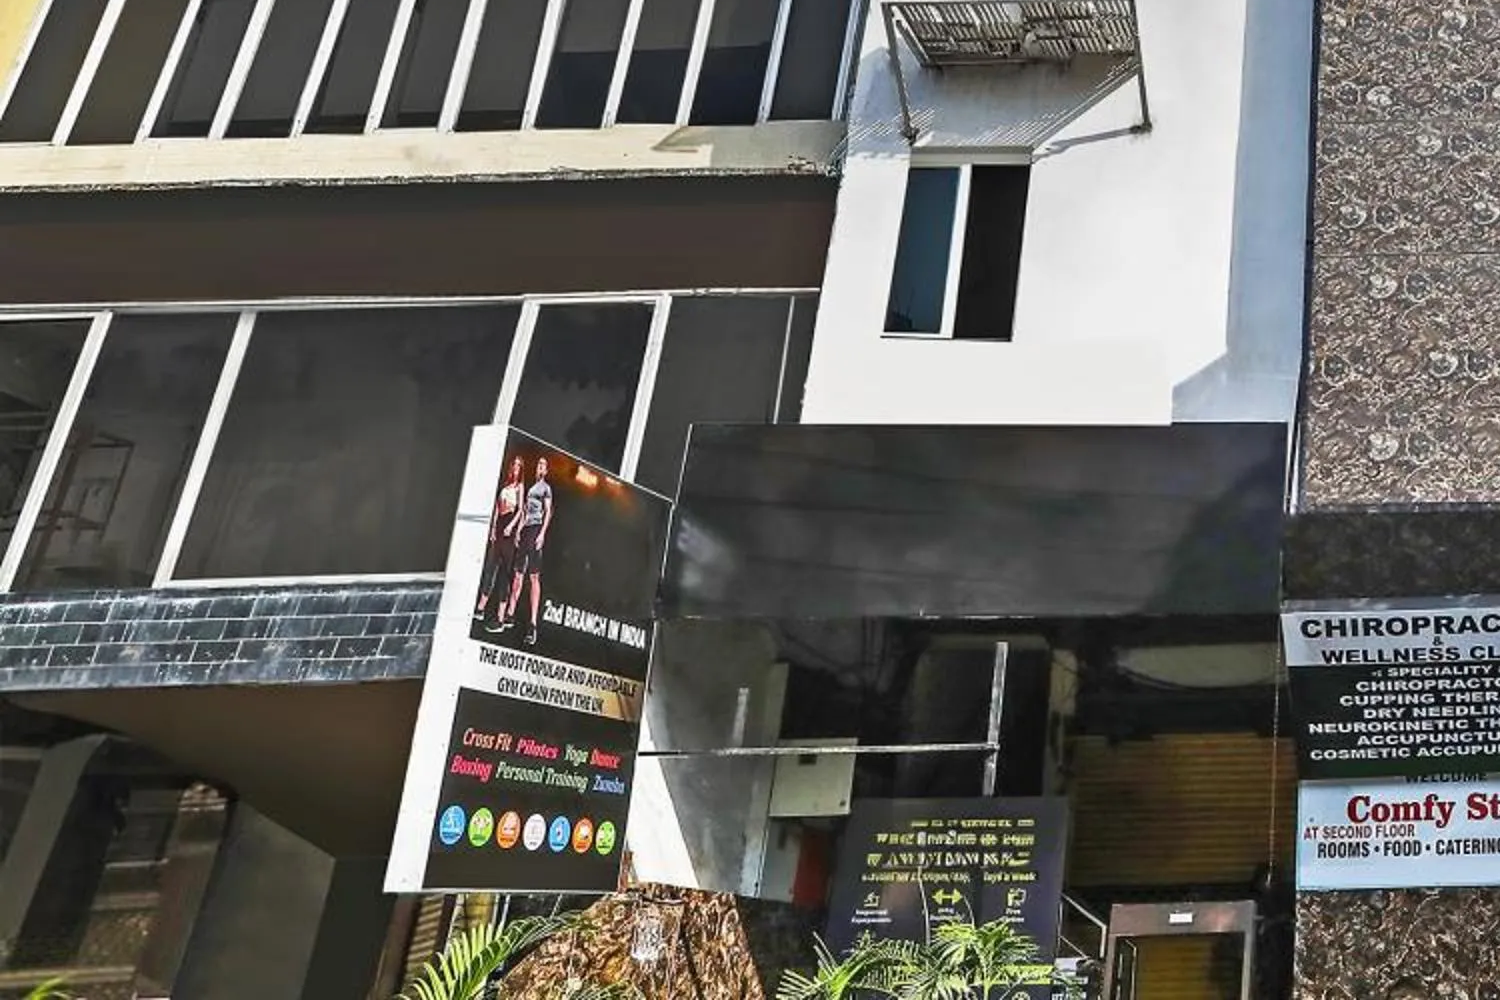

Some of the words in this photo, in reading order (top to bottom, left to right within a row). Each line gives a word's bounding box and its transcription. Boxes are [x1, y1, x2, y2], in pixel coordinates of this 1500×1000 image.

[543, 600, 564, 625] 2nd
[563, 606, 607, 637] BRANCH
[607, 619, 620, 640] IN
[620, 624, 646, 649] INDIA
[1432, 635, 1444, 647] &
[1321, 646, 1461, 665] WELLNESS
[479, 646, 499, 665] THE
[498, 650, 525, 672] MOST
[525, 656, 566, 681] POPULAR
[567, 667, 586, 686] AND
[586, 670, 638, 698] AFFORDABLE
[1387, 665, 1493, 678] SPECIALITY
[497, 677, 518, 697] GYM
[519, 681, 549, 703] CHAIN
[549, 687, 575, 707] FROM
[575, 693, 592, 711] THE
[591, 697, 604, 713] UK
[1339, 693, 1435, 707] CUPPING
[1363, 707, 1406, 720] DRY
[1308, 719, 1469, 735] NEUROKINETIC
[463, 727, 495, 749] Cross
[494, 733, 512, 751] Fit
[515, 738, 560, 760] Pilates
[564, 743, 589, 767] Yoga
[1310, 746, 1411, 760] COSMETIC
[450, 755, 493, 783] Boxing
[495, 761, 544, 785] Personal
[545, 767, 589, 793] Training
[1347, 794, 1456, 829] Comfy
[1304, 827, 1319, 841] AT
[1322, 825, 1374, 840] SECOND
[1375, 824, 1416, 839] FLOOR
[1317, 841, 1370, 859] ROOMS
[1383, 840, 1423, 857] FOOD
